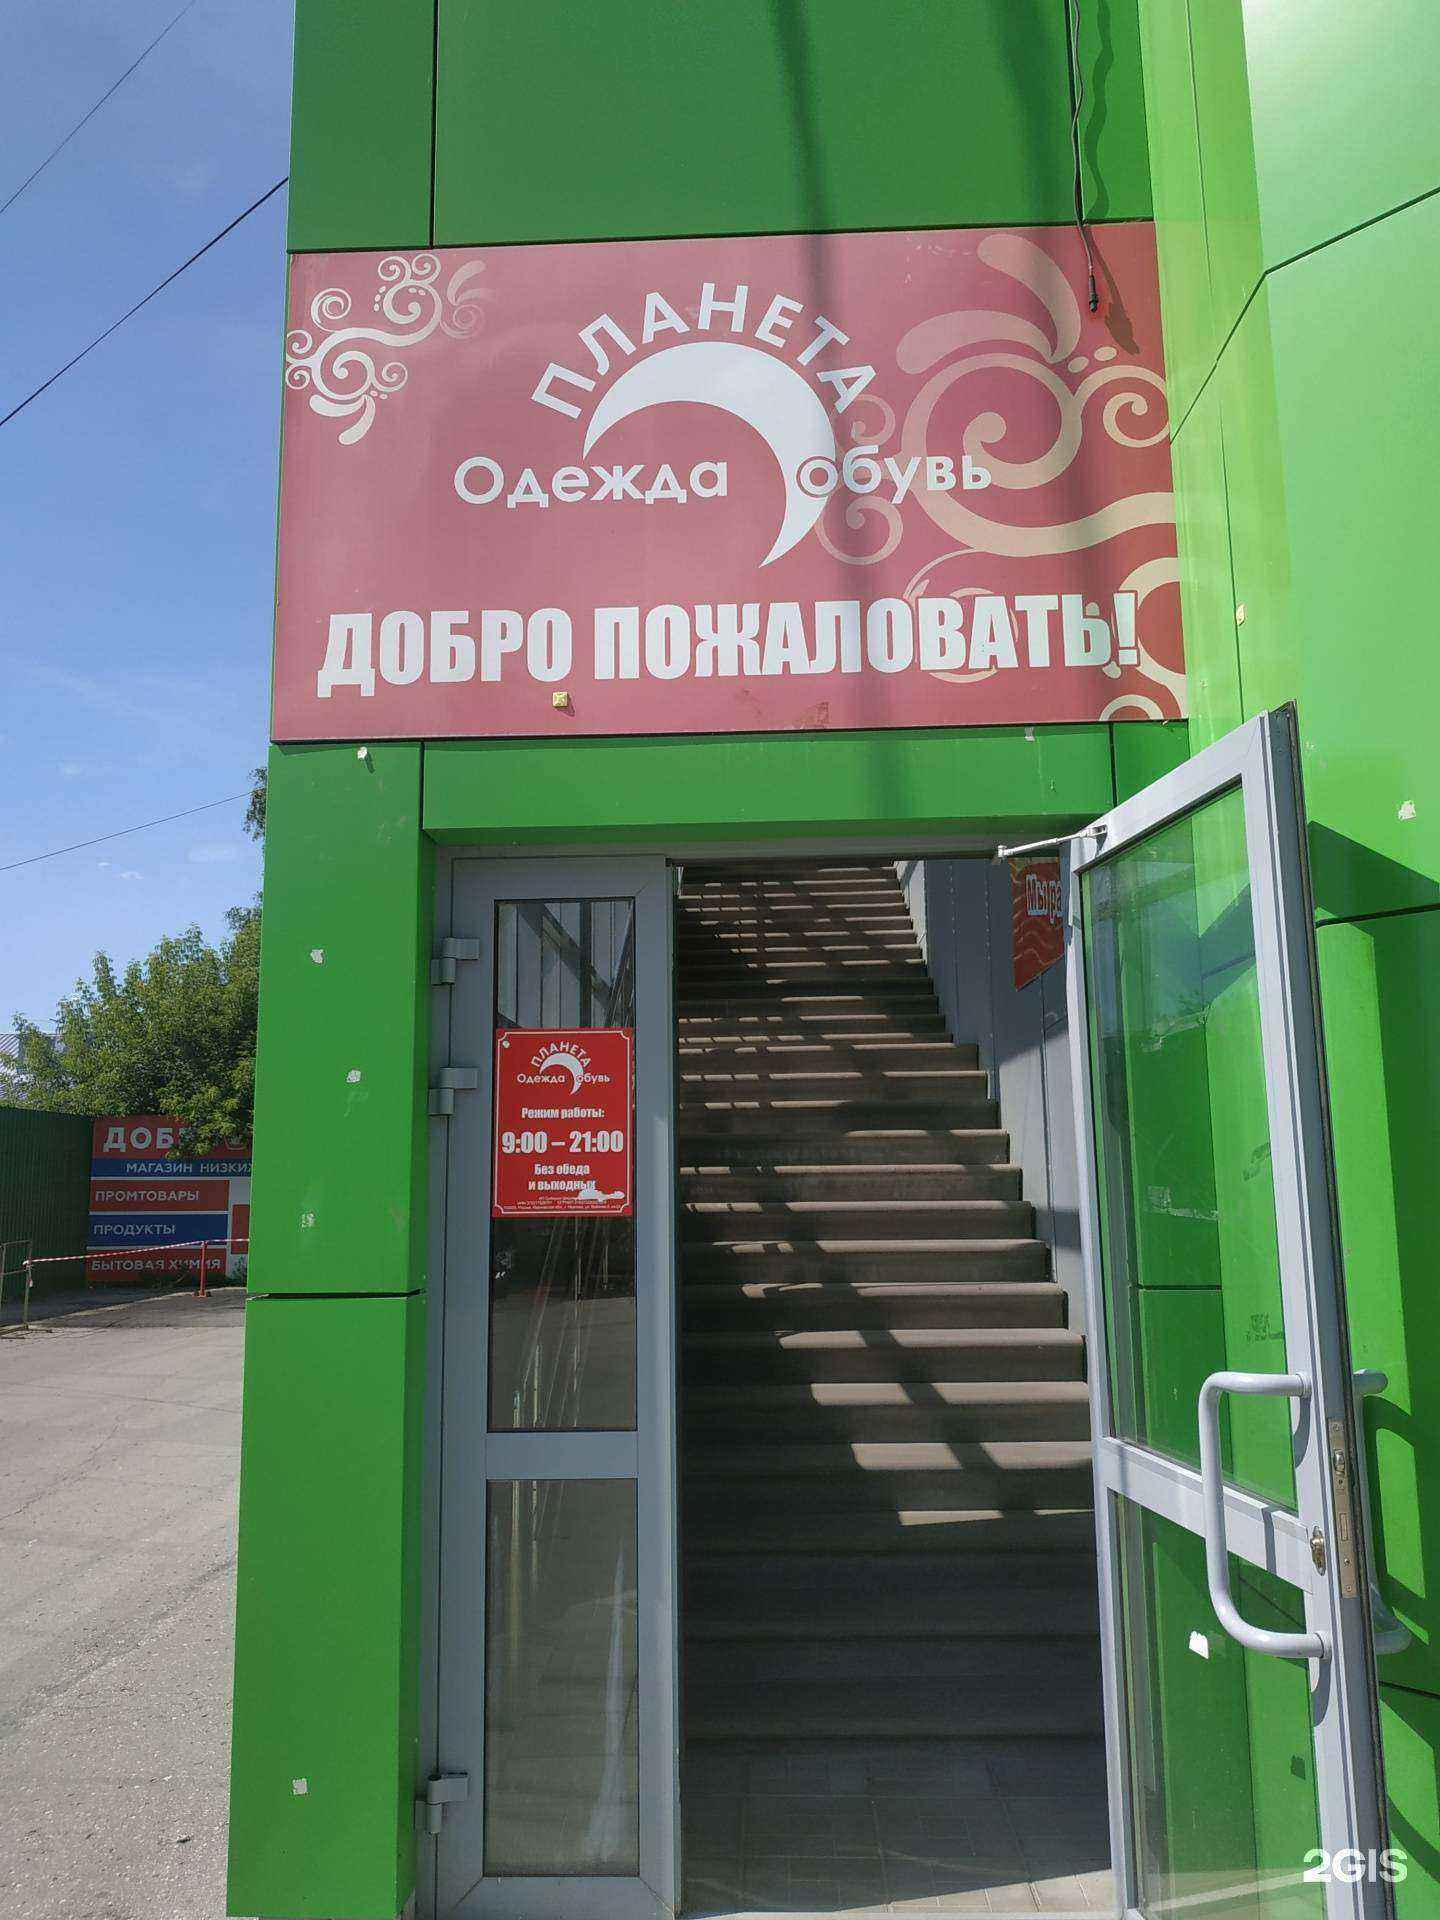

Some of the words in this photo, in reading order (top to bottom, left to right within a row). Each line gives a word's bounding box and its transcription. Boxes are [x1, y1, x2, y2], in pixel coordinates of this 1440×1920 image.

[530, 281, 877, 420] ПЛАНЕТА
[454, 455, 728, 508] Одежда
[796, 444, 992, 506] обувь
[316, 606, 573, 698] ДОБРО
[593, 590, 1140, 681] ПОЖАЛОВАТЬ!
[530, 1041, 591, 1068] ПЛАНЕТА
[516, 1073, 566, 1084] Одежда
[576, 1072, 610, 1084] обувь
[521, 1107, 560, 1119] Режим
[561, 1107, 605, 1119] работы:
[501, 1131, 548, 1153] 9:00
[569, 1130, 624, 1153] 21:00
[126, 1163, 193, 1173] МАГАЗИН
[534, 1163, 554, 1175] Без
[556, 1163, 590, 1176] обеда
[537, 1180, 597, 1192] выходных
[95, 1190, 200, 1201] ПРОМТОВАРЫ
[93, 1224, 176, 1236] ПРОДУКТЫ
[91, 1260, 166, 1271] БЫТОВАЯ
